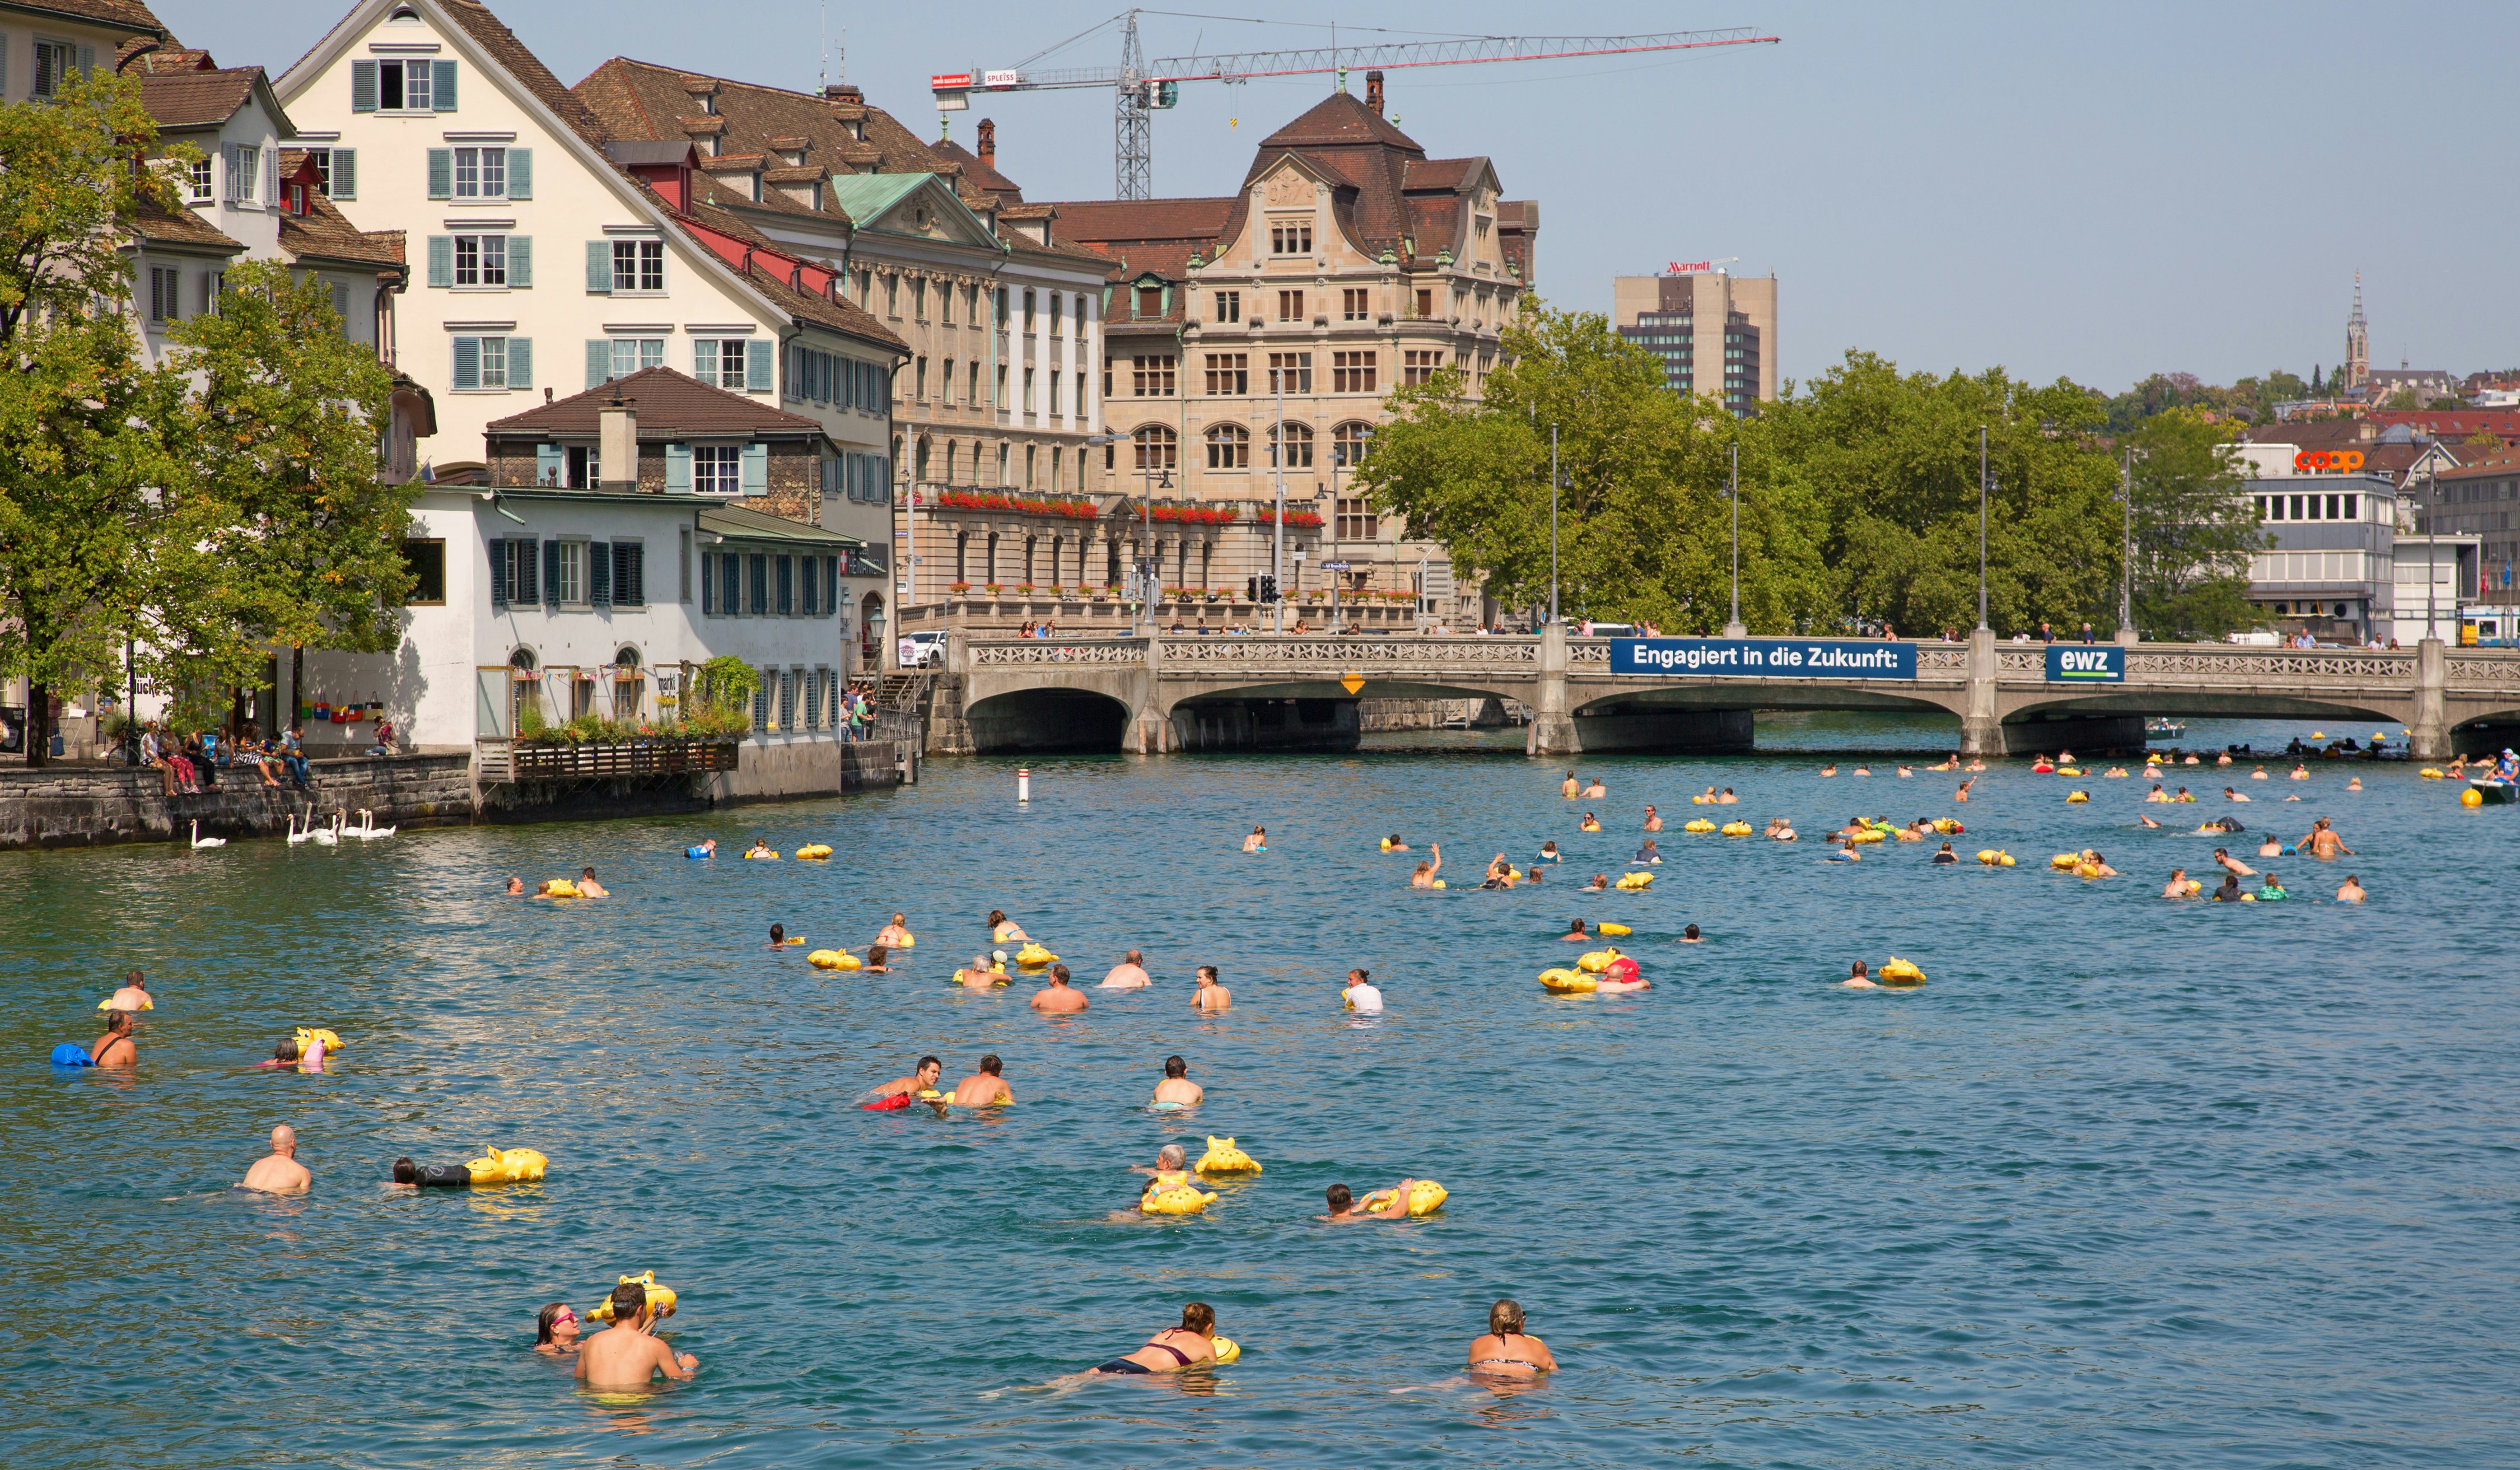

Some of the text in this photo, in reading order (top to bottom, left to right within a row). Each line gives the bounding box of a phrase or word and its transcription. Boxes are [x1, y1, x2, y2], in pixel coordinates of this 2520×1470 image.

[1667, 261, 1710, 273] Marriott
[2294, 451, 2364, 474] coop
[1634, 645, 1897, 669] Engagiert in die Zukunft:
[2061, 651, 2108, 670] ewz
[659, 673, 675, 690] markt
